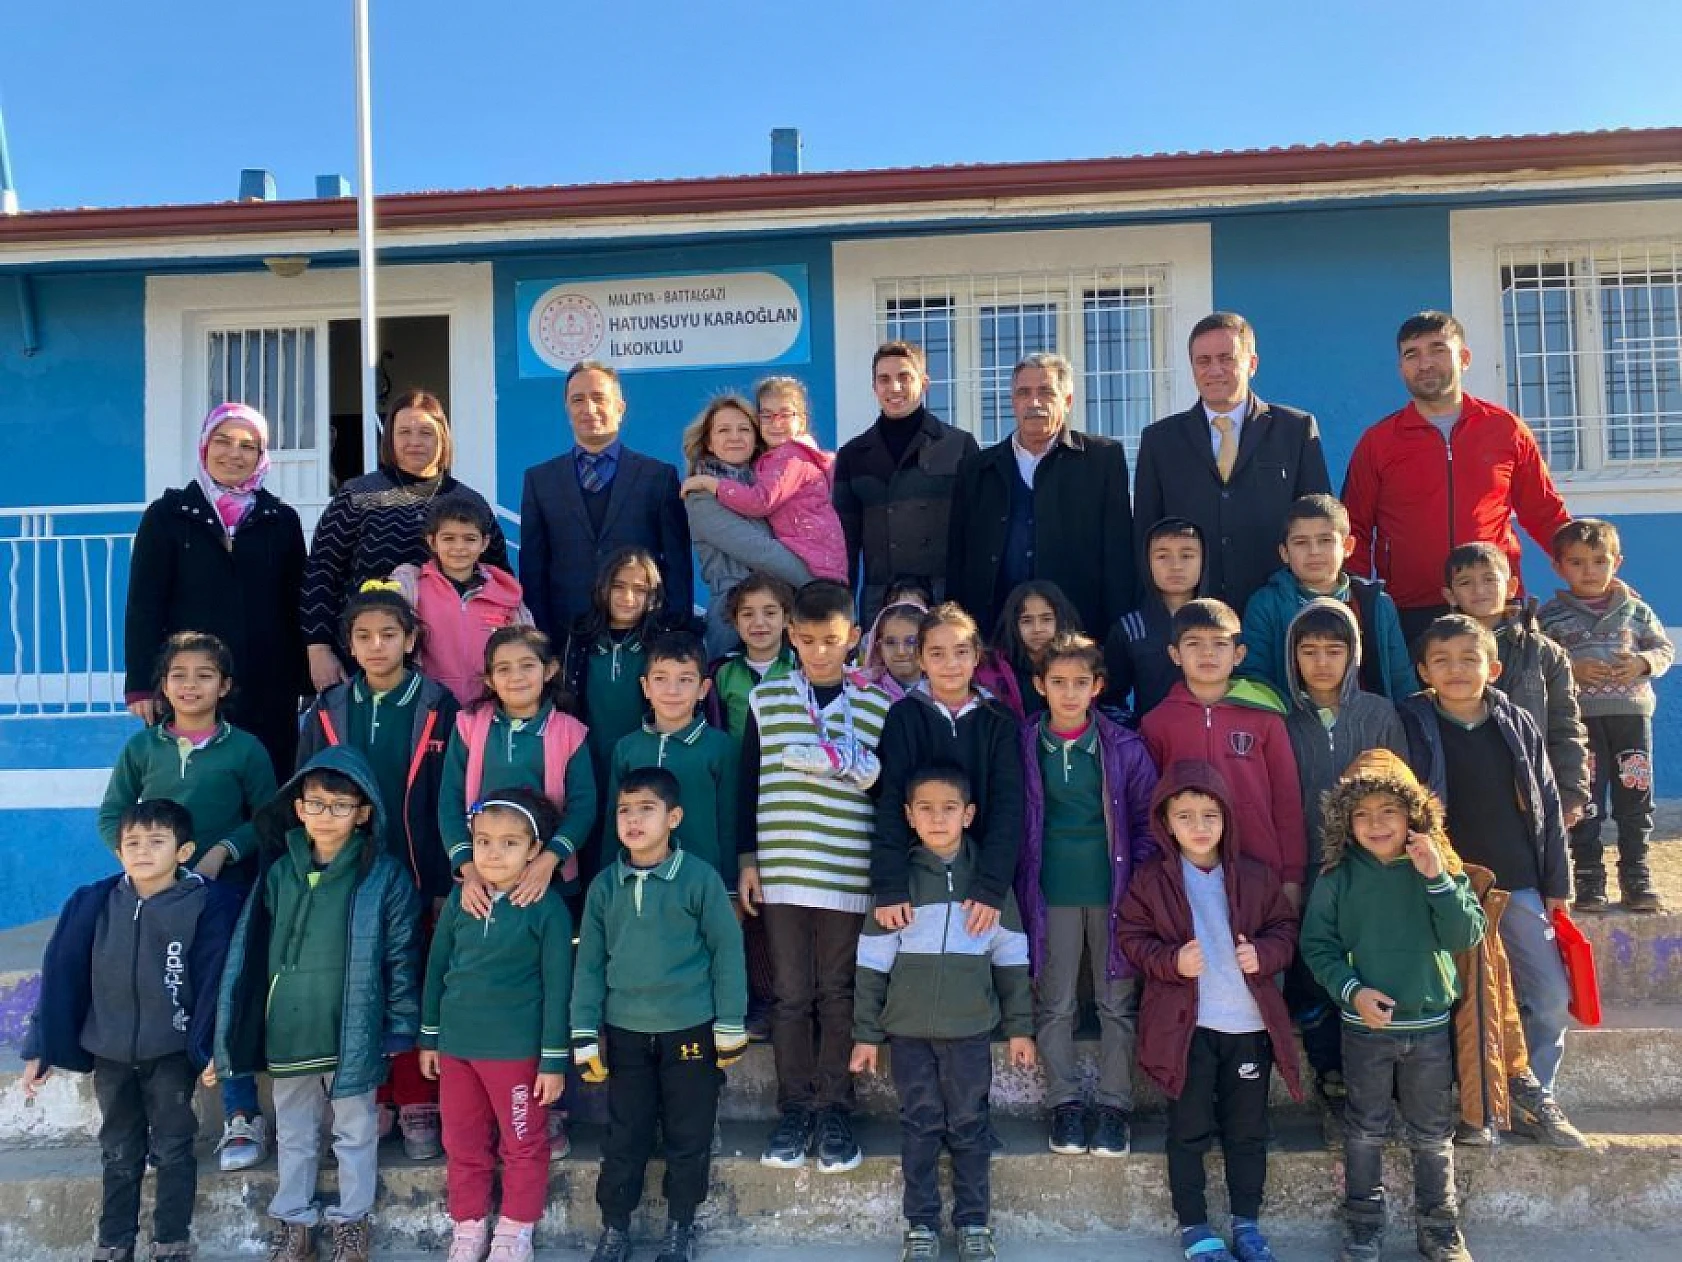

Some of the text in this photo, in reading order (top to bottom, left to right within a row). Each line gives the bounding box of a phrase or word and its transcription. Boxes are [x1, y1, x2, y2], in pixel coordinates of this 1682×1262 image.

[608, 292, 655, 307] MALATYA
[608, 306, 798, 332] HATUNSUYU KARAOĞLAN
[610, 338, 684, 358] İLKOKULU
